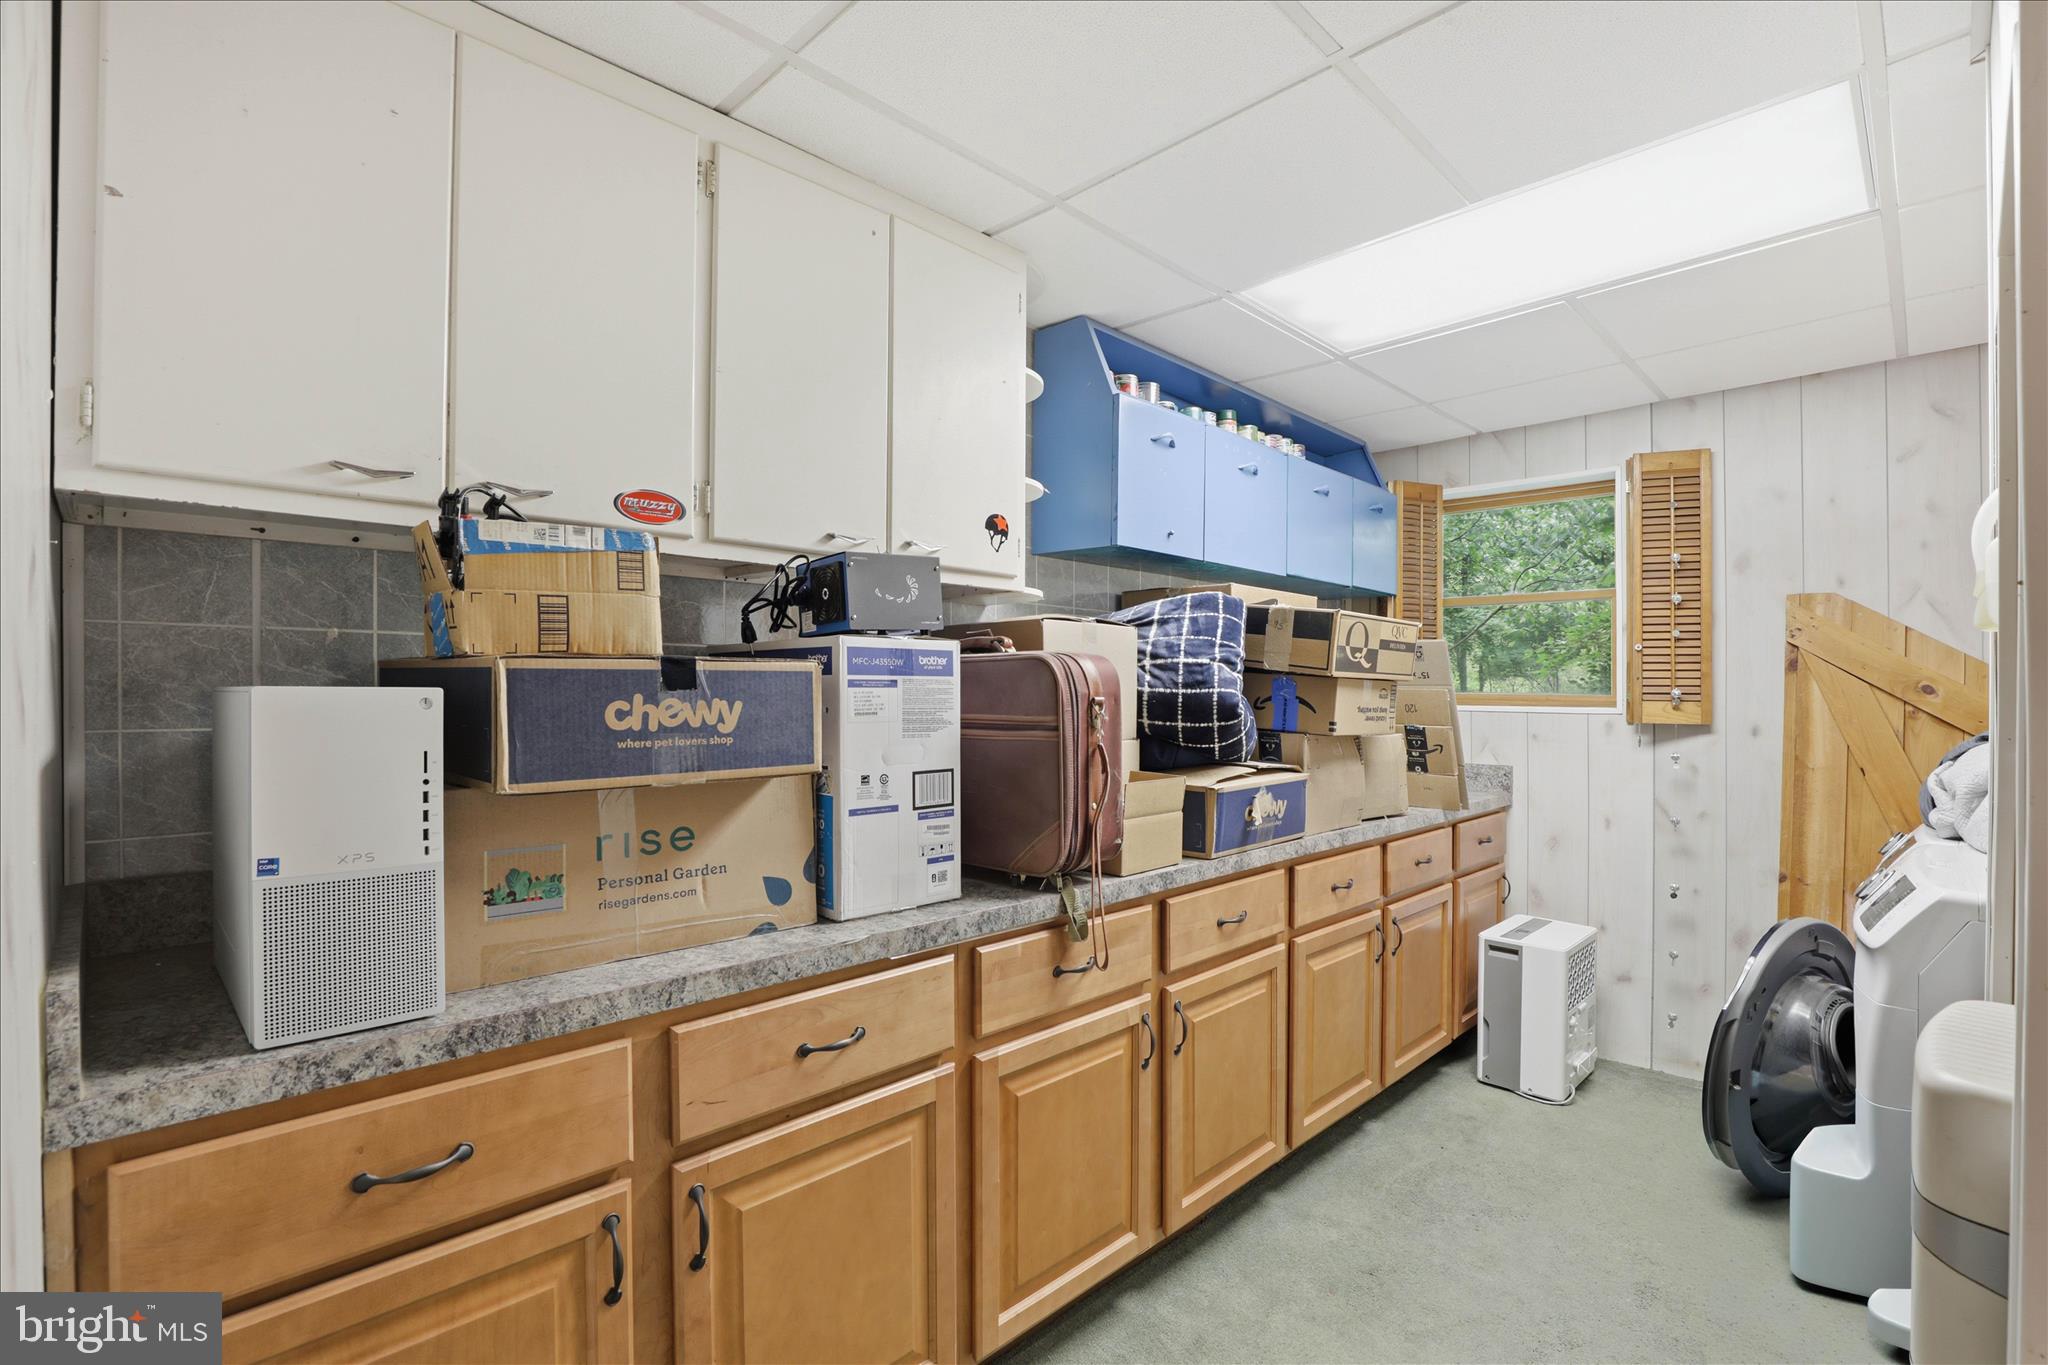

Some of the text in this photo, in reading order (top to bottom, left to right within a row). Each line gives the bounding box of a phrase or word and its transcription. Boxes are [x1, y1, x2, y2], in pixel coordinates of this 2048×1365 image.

[1391, 625, 1408, 639] QVC
[1345, 621, 1372, 669] Q
[918, 655, 948, 666] brother
[604, 693, 743, 734] chewy
[1404, 704, 1418, 713] 120
[617, 735, 734, 749] where pet lovers shop
[596, 826, 696, 862] rise
[337, 852, 376, 865] XPS
[597, 863, 728, 891] Personal Garden
[598, 887, 697, 910] risegardens.com
